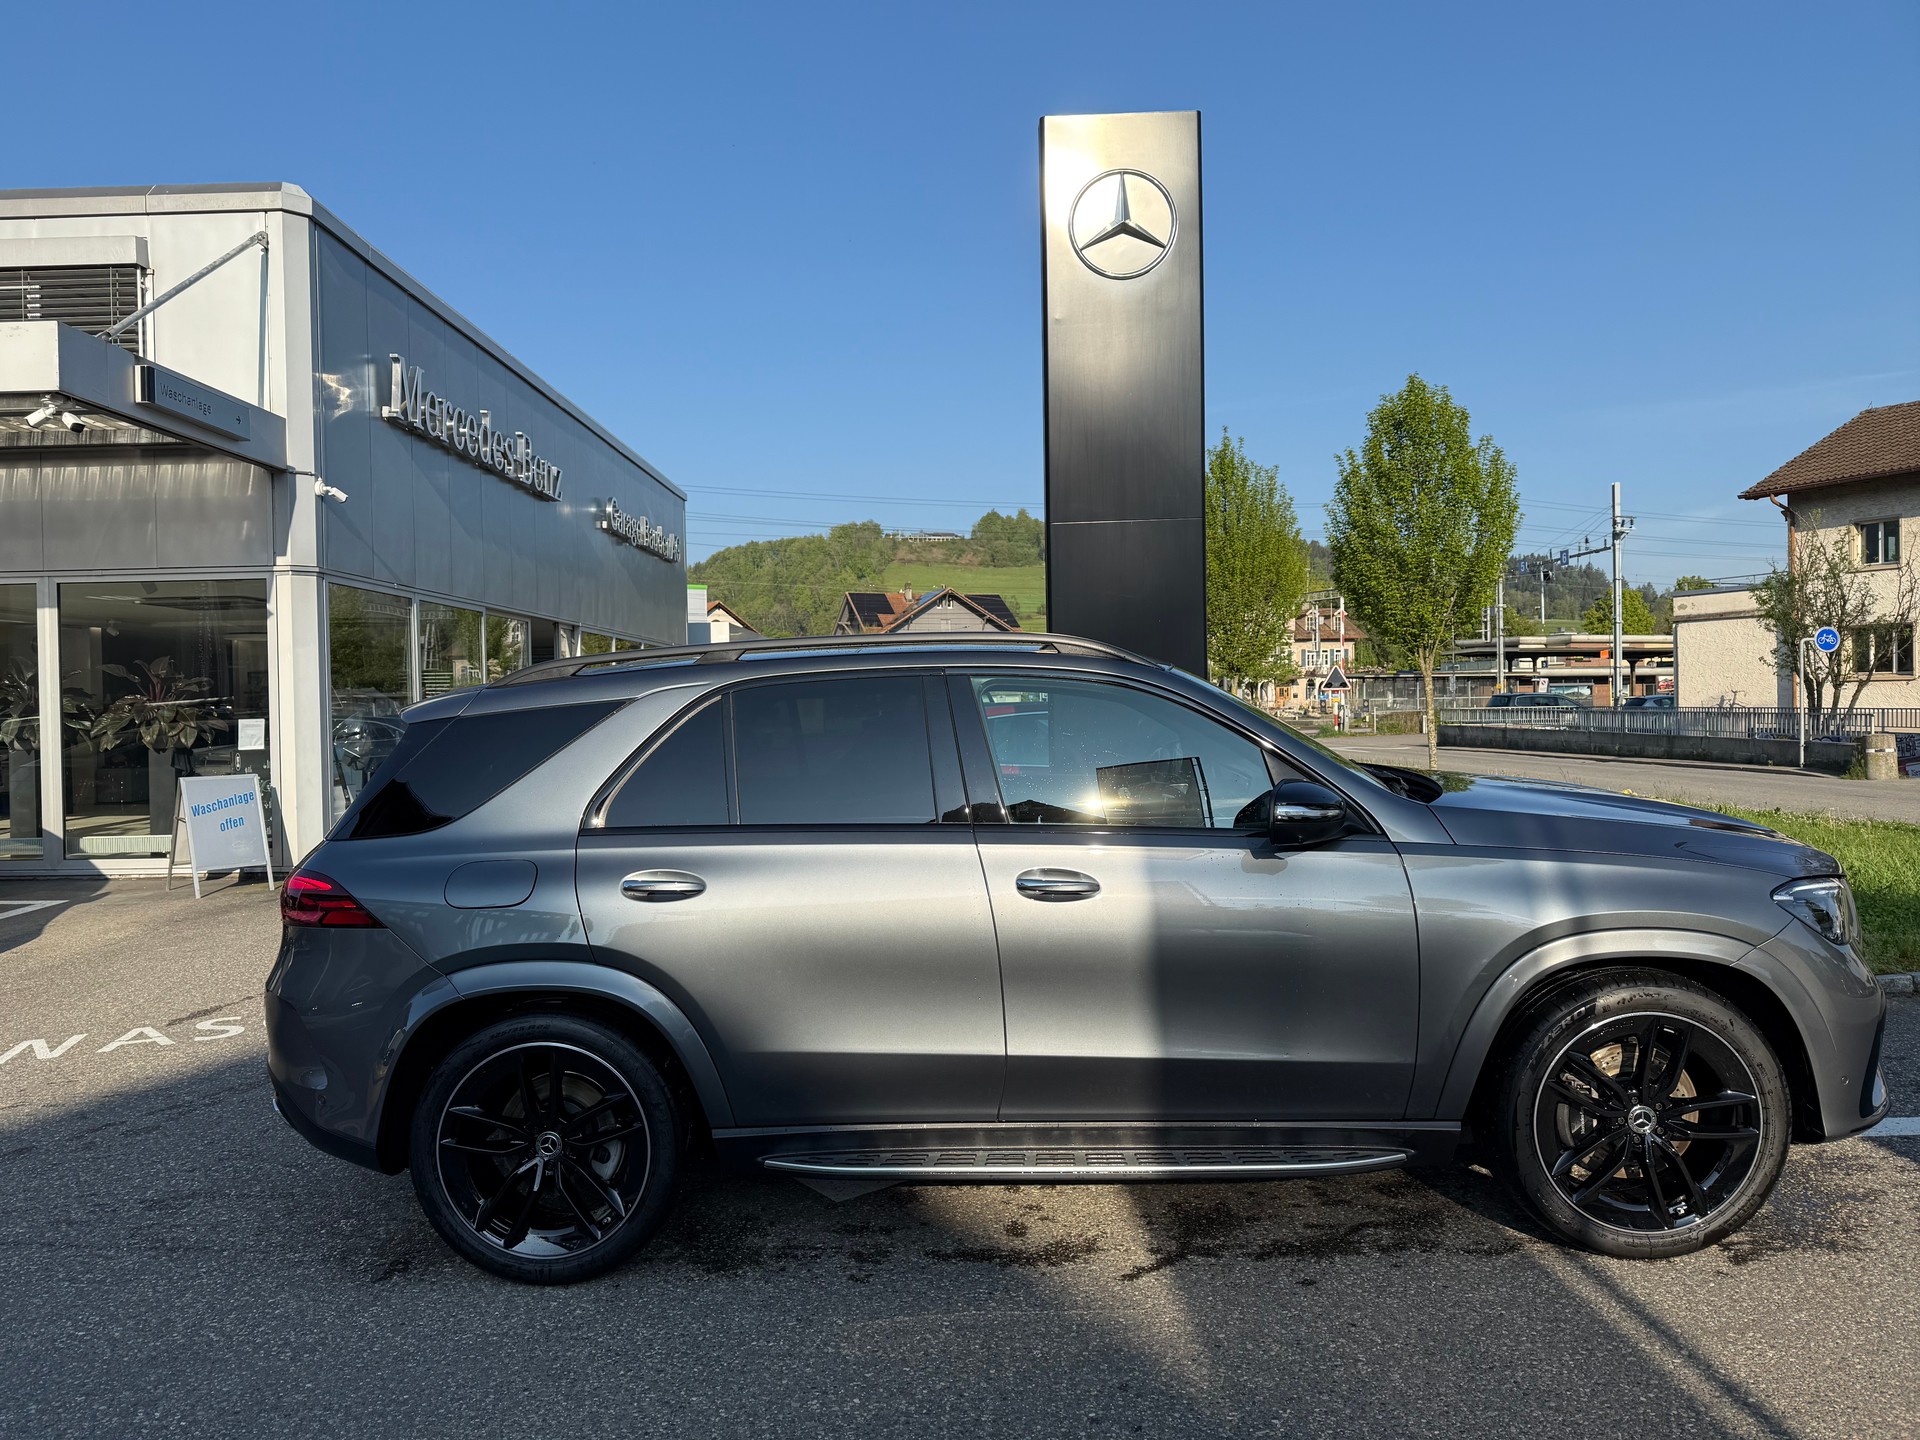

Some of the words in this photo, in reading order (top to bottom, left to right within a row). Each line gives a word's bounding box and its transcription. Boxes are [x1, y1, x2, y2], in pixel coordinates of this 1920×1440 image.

[160, 383, 212, 416] Waschanlage
[607, 497, 642, 547] Garage
[191, 790, 255, 817] Waschanlage
[220, 816, 245, 832] offen
[0, 1016, 267, 1065] WAS
[1542, 1006, 1586, 1049] ZERO
